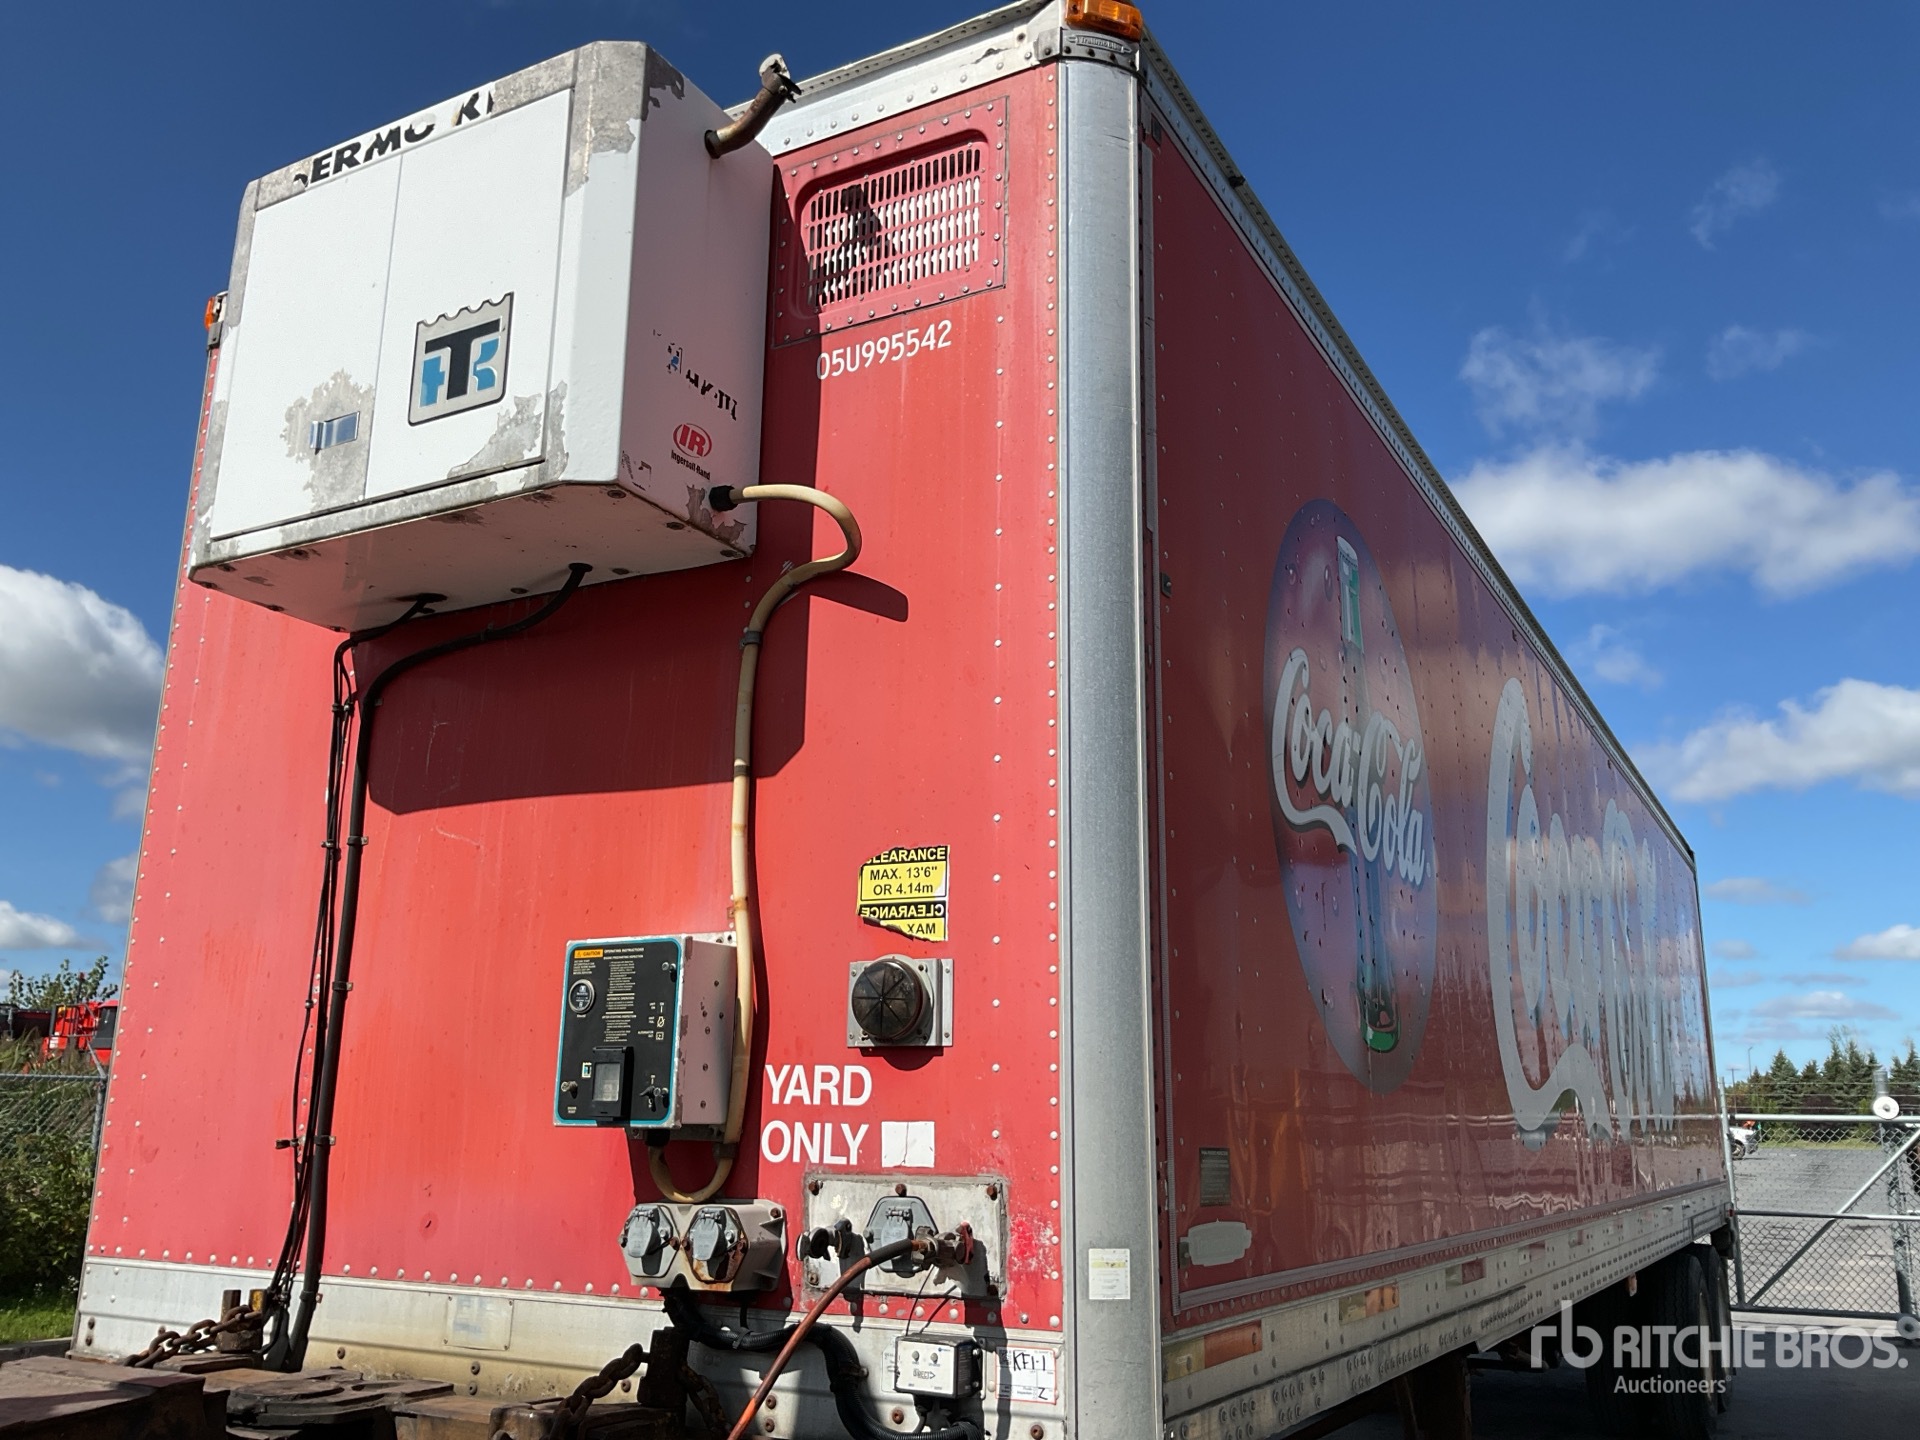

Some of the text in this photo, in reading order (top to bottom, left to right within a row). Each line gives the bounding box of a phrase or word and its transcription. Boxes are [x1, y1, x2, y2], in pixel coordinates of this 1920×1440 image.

[816, 319, 953, 380] 05U995542
[870, 865, 938, 881] MAX. 13'6"
[873, 882, 934, 896] OR 4.14m
[764, 1064, 873, 1106] YARD
[761, 1119, 870, 1166] ONLY
